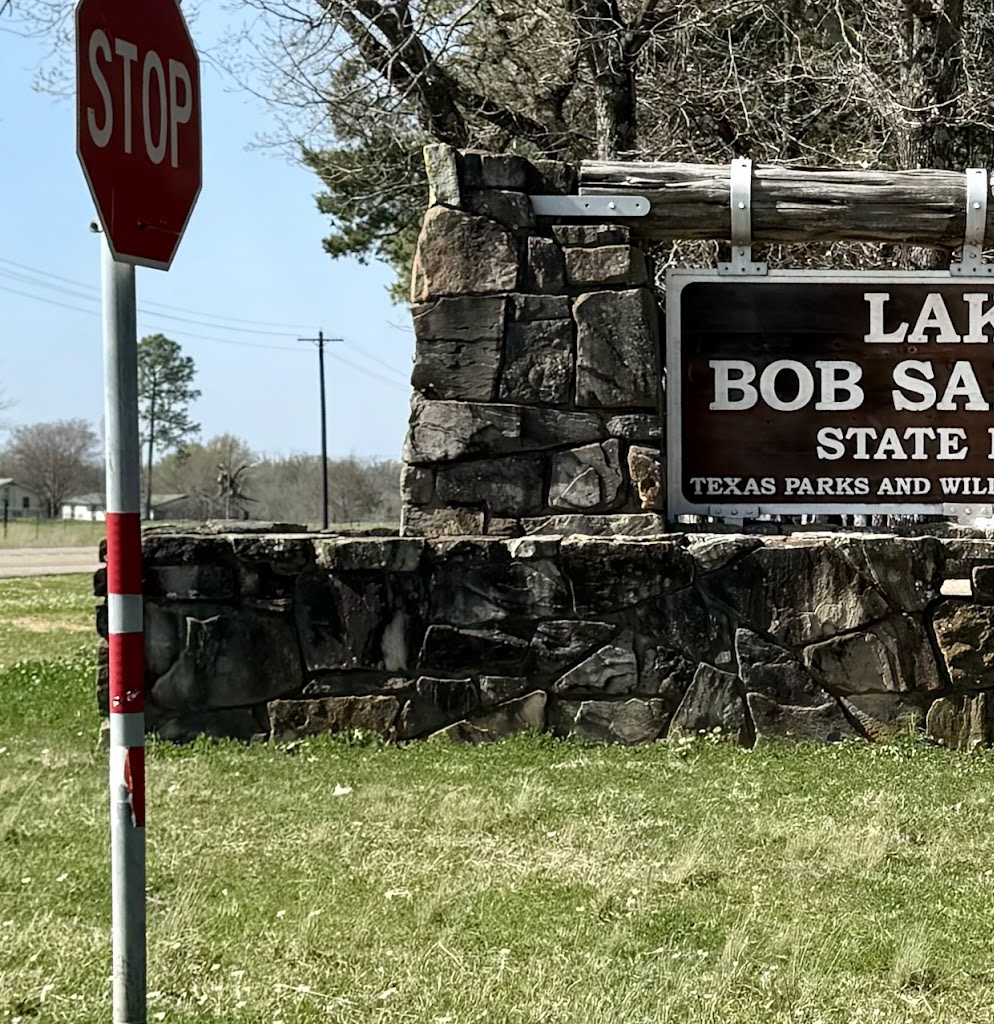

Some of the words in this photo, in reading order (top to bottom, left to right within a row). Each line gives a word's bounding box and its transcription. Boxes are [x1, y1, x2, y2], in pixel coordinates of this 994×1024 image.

[86, 28, 193, 169] STOP
[708, 360, 865, 412] BOB
[815, 427, 969, 460] STATE
[690, 476, 777, 495] TEXAS
[784, 477, 870, 495] PARKS
[876, 477, 931, 495] AND
